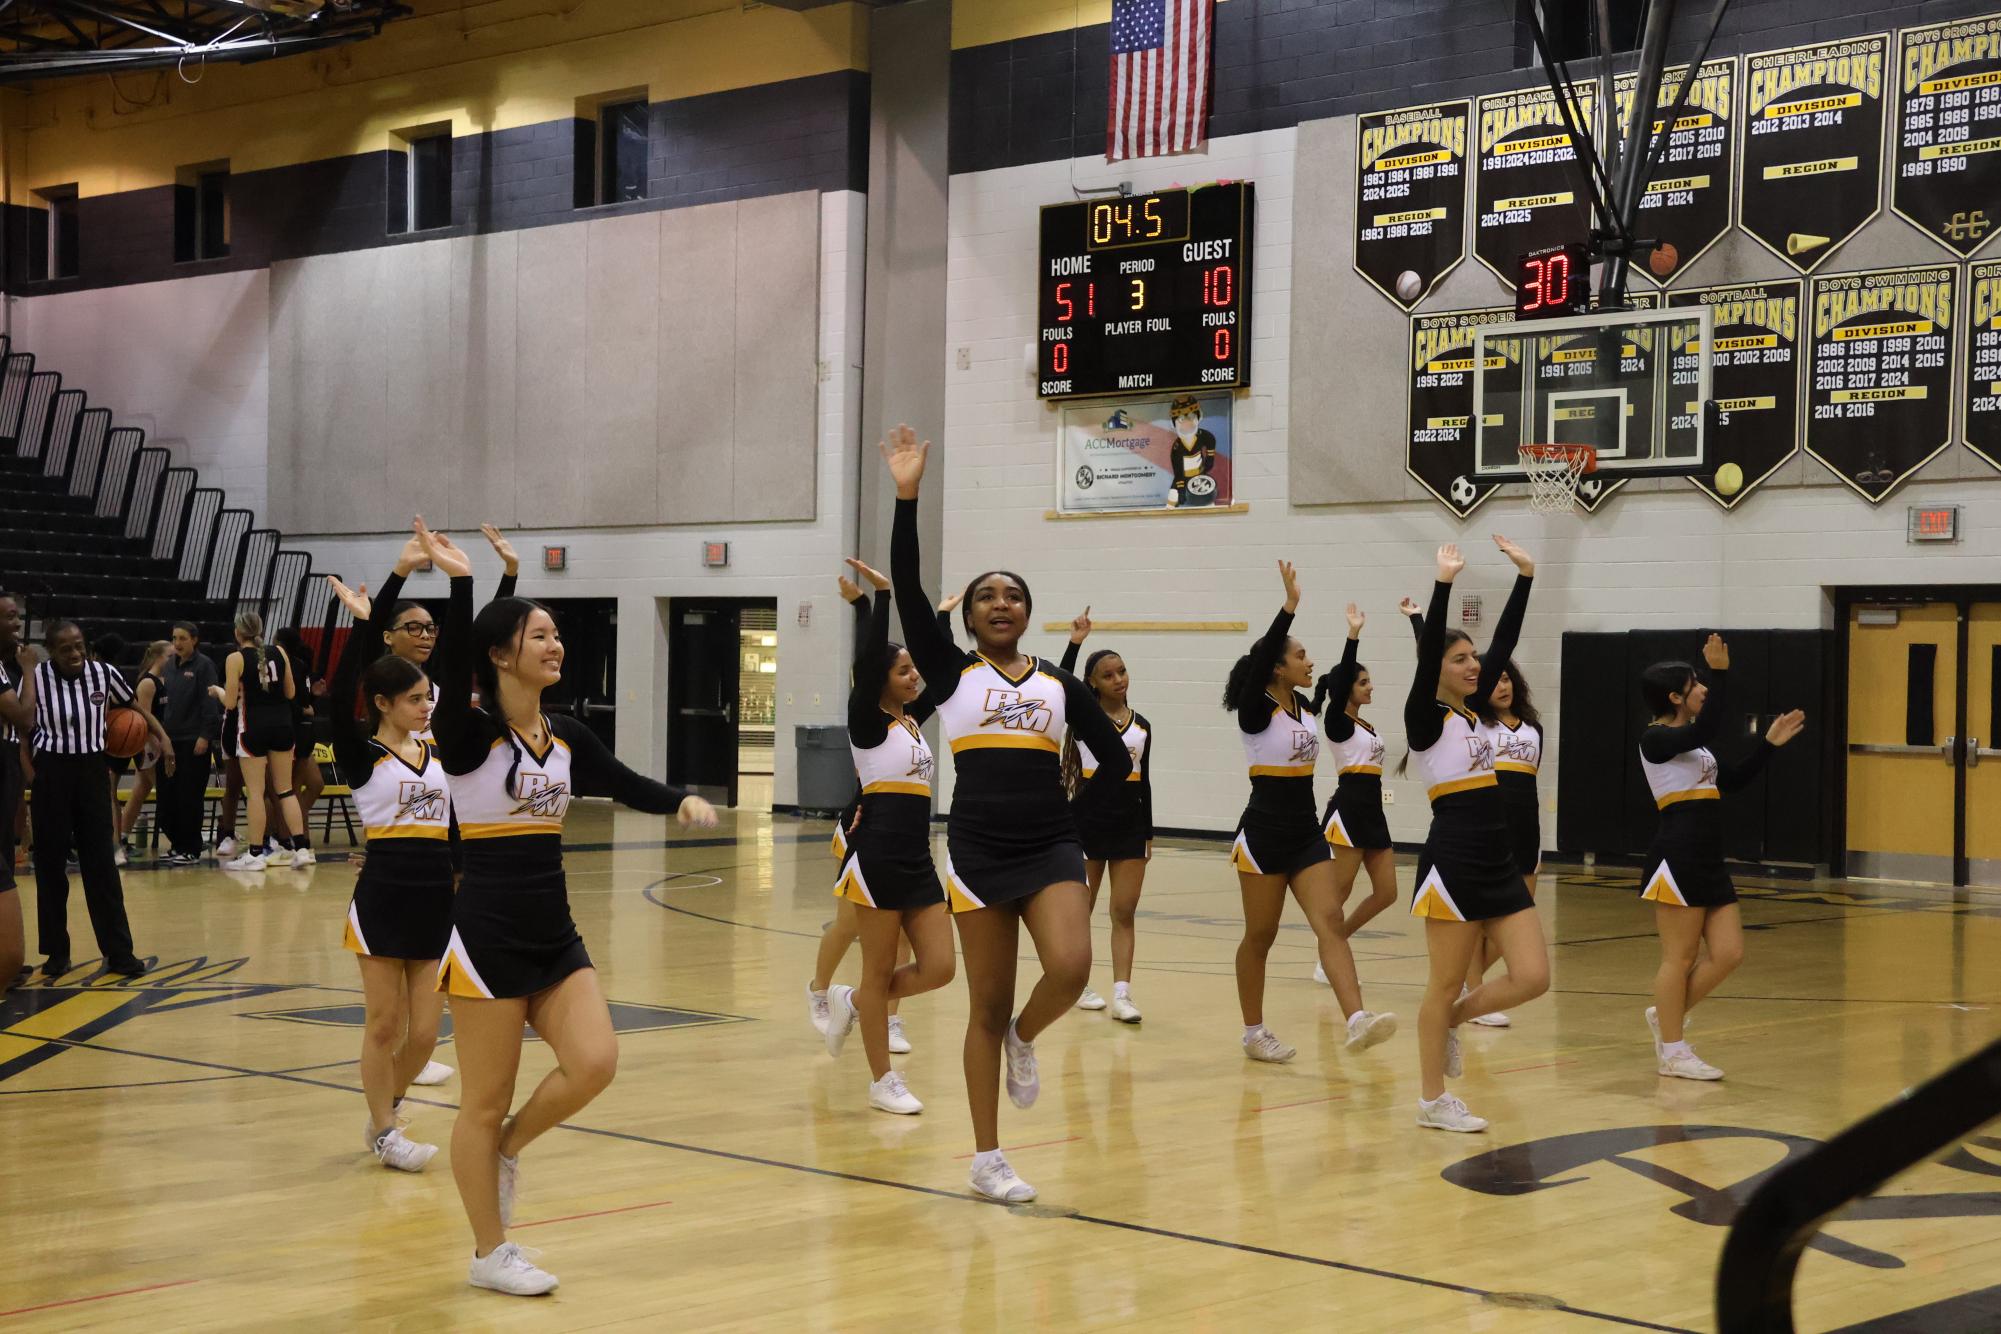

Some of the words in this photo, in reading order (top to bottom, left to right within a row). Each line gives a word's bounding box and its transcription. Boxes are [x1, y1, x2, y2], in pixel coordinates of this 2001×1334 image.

[1906, 30, 1940, 46] BOYS
[1942, 22, 1986, 40] CROSS
[1752, 40, 1882, 69] CHEERLEADING
[1904, 32, 2001, 94] CHAMPI
[1614, 78, 1637, 91] BOY
[1750, 52, 1882, 116] CHAMPIONS
[1933, 74, 2001, 92] DIVISIO
[1482, 96, 1516, 111] GIRLS
[1777, 98, 1847, 114] DIVISION
[1906, 96, 1934, 114] 1979
[1940, 91, 1970, 108] 1980
[1974, 87, 2001, 104] 198
[1385, 108, 1442, 125] BASEBALL
[1752, 118, 1779, 135] 2012
[1782, 114, 1810, 131] 2013
[1814, 110, 1842, 126] 2014
[1905, 114, 1934, 130] 1985
[1939, 108, 1969, 126] 1989
[1362, 116, 1465, 170] CHAMPIONS
[1504, 136, 1563, 152] DIVISION
[1670, 131, 1695, 146] 2005
[1698, 126, 1725, 142] 2010
[1904, 130, 1933, 147] 2004
[1938, 126, 1969, 143] 2009
[1669, 146, 1694, 162] 2017
[1697, 143, 1721, 159] 2019
[1938, 139, 2001, 155] REGION
[1384, 153, 1439, 168] DIVISION
[1782, 161, 1838, 175] REGION
[1902, 161, 1932, 178] 1989
[1936, 156, 1966, 174] 1990
[1363, 172, 1385, 187] 1983
[1388, 169, 1410, 183] 1984
[1412, 166, 1434, 180] 1989
[1437, 163, 1458, 177] 1991
[1363, 187, 1385, 201] 2024
[1386, 184, 1410, 198] 2025
[1649, 180, 1692, 192] EGION
[1508, 196, 1557, 208] REGION
[1668, 191, 1694, 206] 2024
[1094, 197, 1163, 243] 04.5
[1388, 211, 1432, 223] REGION
[1482, 213, 1504, 227] 2024
[1505, 209, 1531, 224] 2025
[1361, 228, 1384, 241] 1983
[1182, 238, 1232, 262] GUEST
[1528, 244, 1565, 257] DAKTRONICS
[1050, 255, 1092, 277] HOME
[1120, 258, 1156, 275] PERIOD
[1204, 266, 1232, 306] 10
[1523, 254, 1568, 311] 30
[1818, 278, 1861, 292] BOYS
[1865, 270, 1950, 288] SWIMMING
[1131, 279, 1145, 310] 3
[1700, 288, 1768, 304] SOFTBALL
[1816, 282, 1952, 338] CHAMPIONS
[1105, 320, 1142, 336] PLAYER
[1146, 317, 1172, 332] FOUL
[1202, 311, 1236, 327] FOULS
[1421, 316, 1457, 328] BOYS
[1460, 312, 1516, 326] SOCCER
[1042, 326, 1073, 341] FOULS
[1844, 324, 1917, 338] DIVISION
[1976, 332, 2001, 347] 198
[1214, 328, 1230, 360] 0
[1415, 326, 1520, 372] CHAMPS
[1715, 338, 1765, 349] VISION
[1818, 342, 1845, 358] 1986
[1849, 340, 1878, 355] 1998
[1883, 338, 1910, 353] 1999
[1916, 336, 1945, 350] 2001
[1053, 343, 1069, 373] 0
[1442, 358, 1498, 370] DIVISON
[1673, 356, 1698, 370] 1998
[1734, 350, 1760, 364] 2002
[1763, 348, 1790, 362] 2009
[1816, 359, 1844, 374] 2002
[1882, 354, 1910, 370] 2014
[1916, 353, 1944, 368] 2015
[1201, 367, 1235, 382] SCORE
[1540, 364, 1564, 378] 1991
[1568, 362, 1592, 375] 2005
[1620, 358, 1645, 372] 2024
[1118, 374, 1153, 390] MATCH
[1416, 375, 1438, 388] 1995
[1440, 373, 1463, 386] 2022
[1672, 371, 1698, 384] 2010
[1816, 375, 1844, 390] 2016
[1848, 373, 1876, 388] 2017
[1881, 372, 1909, 386] 2024
[1042, 380, 1072, 395] SCORE
[1850, 389, 1906, 400] REGION
[1720, 400, 1756, 410] GION
[1815, 404, 1842, 418] 2014
[1846, 402, 1875, 418] 2016
[1084, 437, 1151, 450] ACCMortgage
[1414, 430, 1436, 442] 2022
[1438, 429, 1460, 441] 2024
